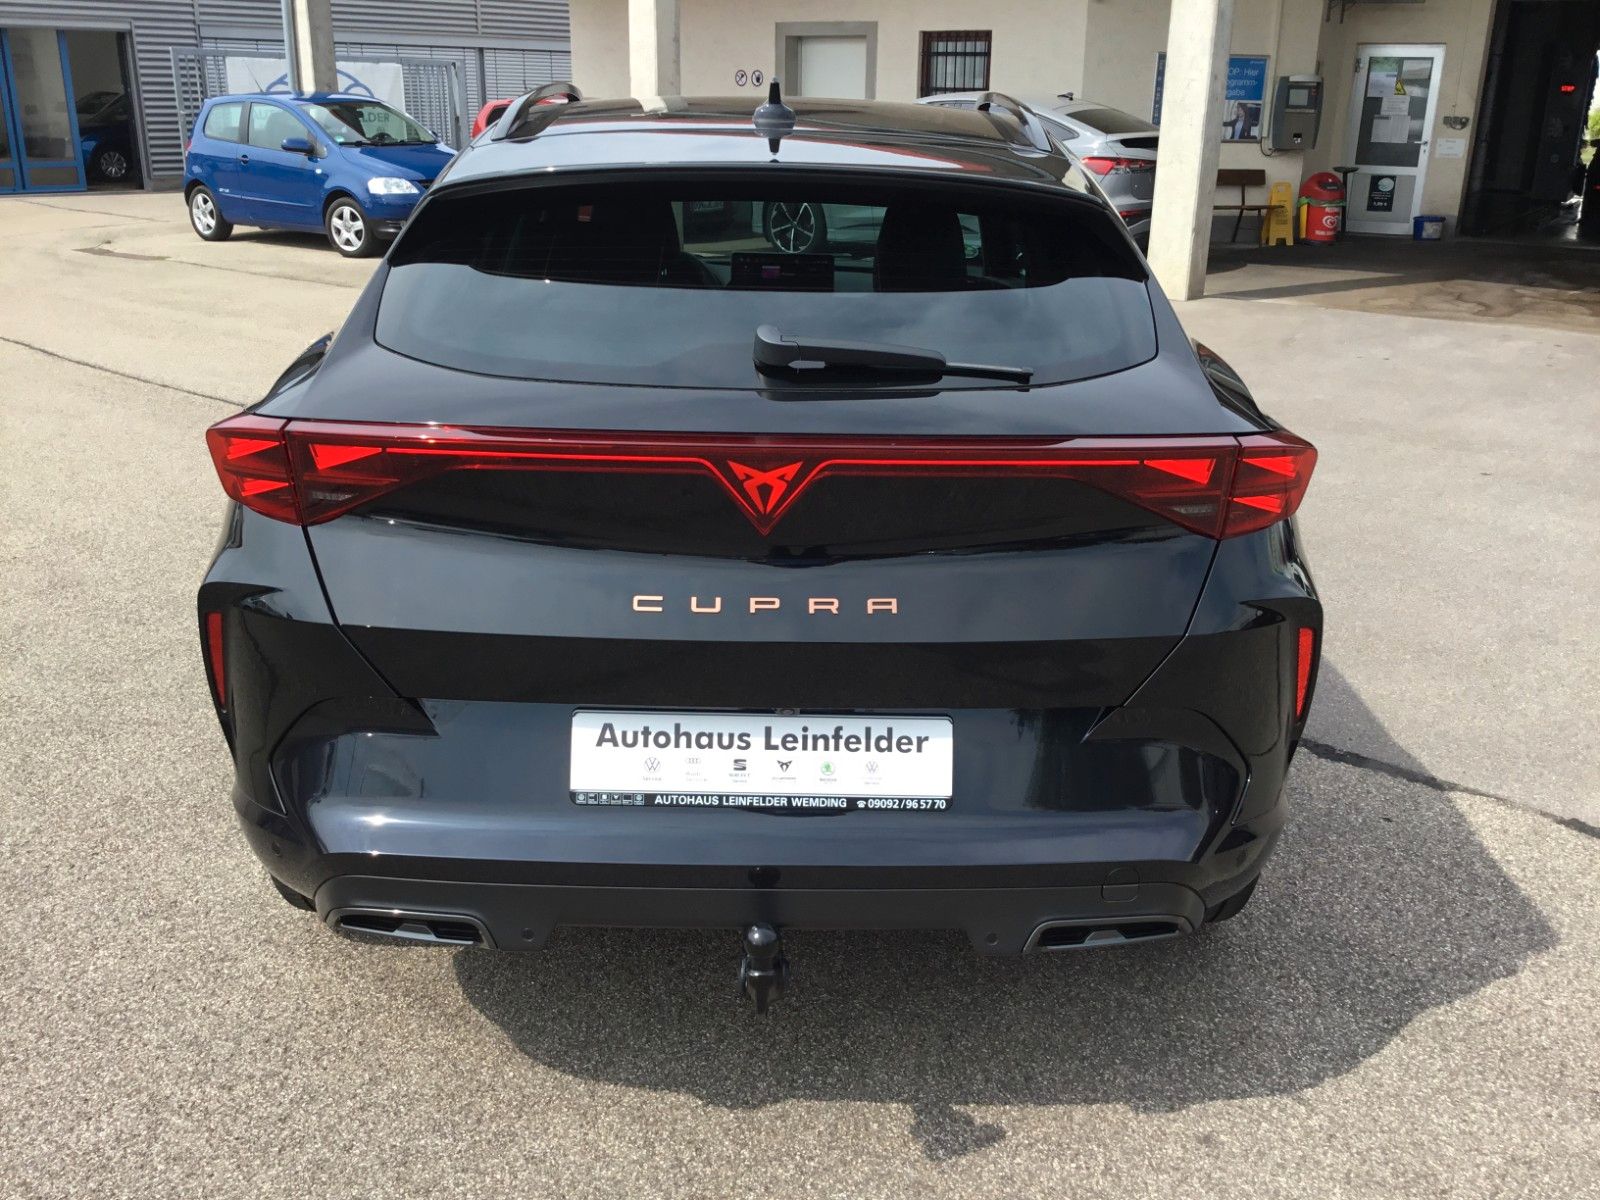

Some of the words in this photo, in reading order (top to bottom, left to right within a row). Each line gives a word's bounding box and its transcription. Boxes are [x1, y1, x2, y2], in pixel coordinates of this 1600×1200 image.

[632, 595, 898, 614] CUPRA
[595, 722, 752, 751] Autohaus
[763, 725, 930, 754] Leinfelder
[654, 794, 720, 806] AUTOHAUS
[722, 796, 788, 807] LEINFELDER
[790, 797, 848, 808] WEMDING
